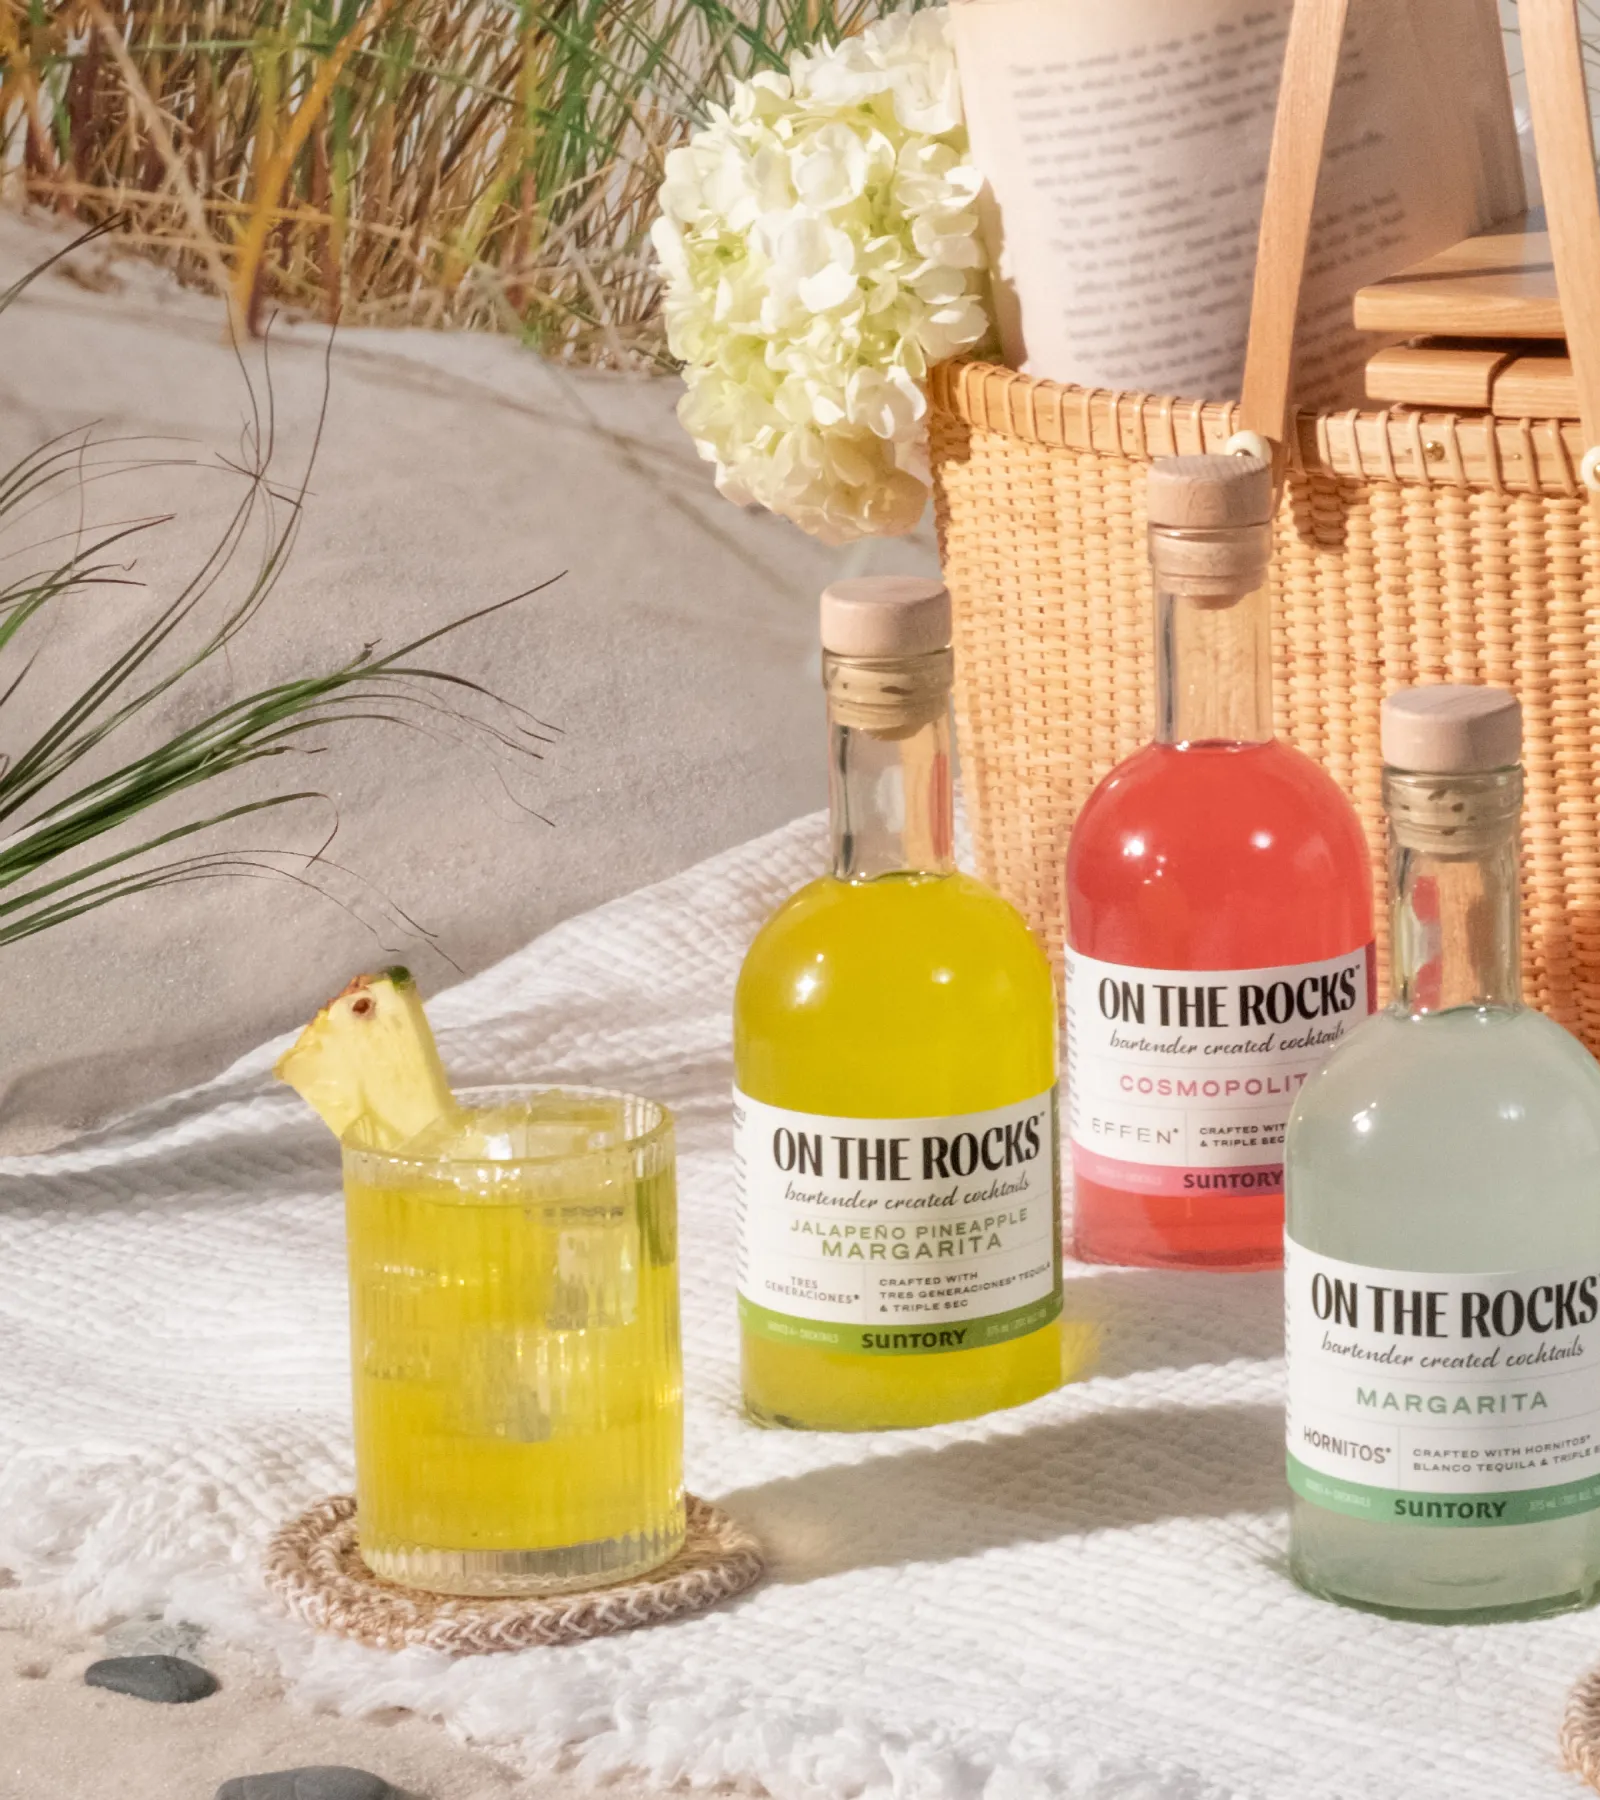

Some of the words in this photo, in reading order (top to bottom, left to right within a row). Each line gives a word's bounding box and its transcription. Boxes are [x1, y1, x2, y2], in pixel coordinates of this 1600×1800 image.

[1099, 977, 1145, 1025] ON
[1152, 985, 1229, 1028] THE
[1109, 1027, 1198, 1055] bartender
[1204, 1032, 1276, 1056] created
[1119, 1072, 1308, 1097] COSMOPOLIT
[1199, 1125, 1259, 1135] CRAFTED
[1262, 1122, 1287, 1133] WIT
[1213, 1137, 1258, 1148] TRIPLE
[1262, 1135, 1285, 1146] SEC
[773, 1126, 823, 1177] ON
[831, 1135, 911, 1181] THE
[784, 1180, 879, 1209] bartender
[884, 1187, 958, 1210] created
[963, 1169, 1031, 1205] cocktails
[790, 1217, 906, 1241] JALAPEÑO
[916, 1207, 1028, 1238] PINEAPPLE
[821, 1232, 1003, 1261] MARGARITA
[790, 1275, 818, 1290] TRES
[879, 1274, 941, 1287] CRAFTED
[946, 1271, 978, 1283] WITH
[880, 1290, 914, 1301] TRES
[1018, 1262, 1051, 1282] TEQUILA
[880, 1303, 888, 1313] &
[893, 1301, 939, 1313] TRIPLE
[944, 1299, 969, 1311] SEC
[1311, 1272, 1358, 1328] ON
[1366, 1285, 1448, 1338] THE
[1321, 1330, 1413, 1367] bartender
[1420, 1346, 1501, 1369] created
[1506, 1334, 1585, 1368] cocktails
[1356, 1386, 1549, 1414] MARGARITA
[1413, 1447, 1480, 1459] CRAFTED
[1484, 1447, 1521, 1458] WITH
[1413, 1463, 1472, 1473] BLANCO
[1477, 1460, 1536, 1473] TEQUILA
[1540, 1458, 1549, 1467] &
[1553, 1448, 1591, 1465] TRIPLE
